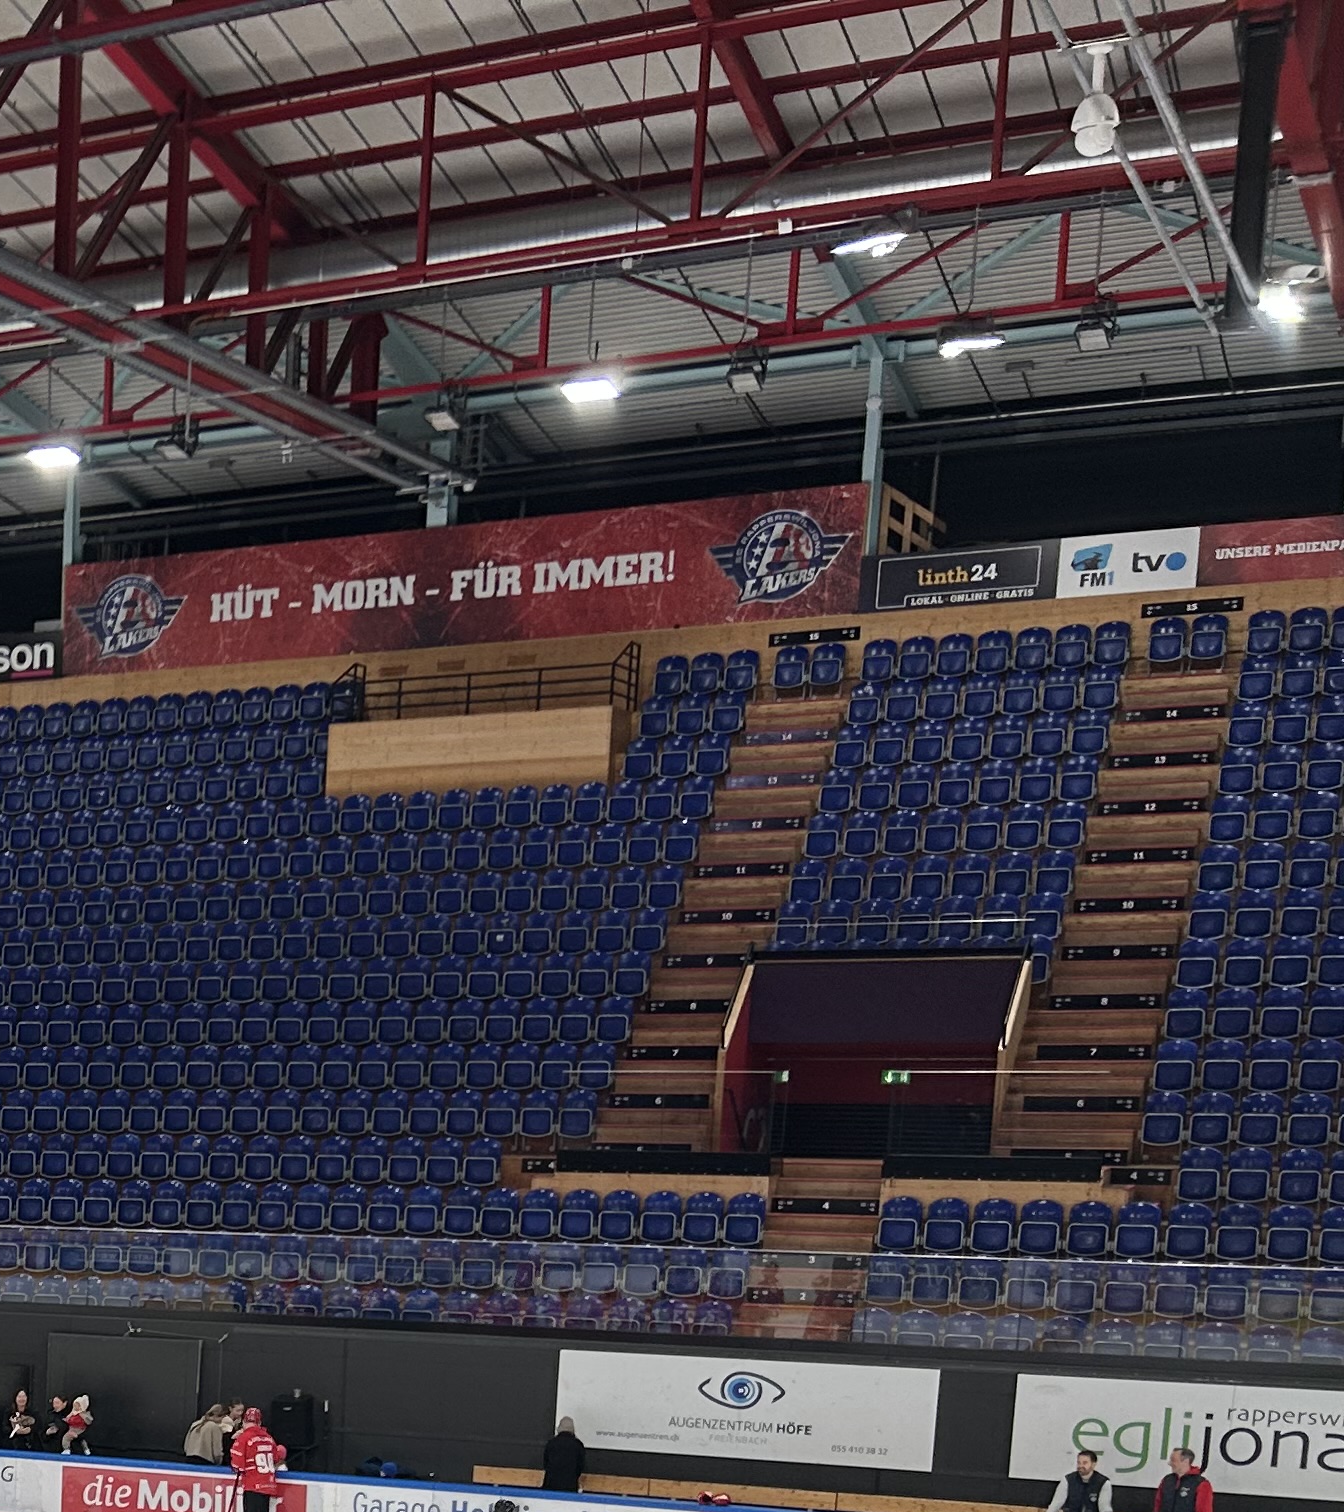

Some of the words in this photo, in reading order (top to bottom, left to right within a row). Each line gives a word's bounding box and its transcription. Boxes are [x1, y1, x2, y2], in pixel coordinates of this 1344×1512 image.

[1214, 545, 1271, 560] UNSERE
[211, 584, 279, 623] HÜT
[312, 574, 416, 614] MORN
[450, 561, 522, 602] FÜR
[532, 549, 675, 595] IMMER!
[736, 566, 816, 605] LAKERS
[917, 562, 999, 587] linth24
[910, 595, 944, 607] LOKAL
[949, 591, 990, 603] ONLINE
[995, 588, 1034, 600] GRATIS
[99, 625, 163, 661] LAKERS
[668, 1416, 773, 1434] AUGENZENTRUM
[776, 1421, 812, 1436] HÖFE
[82, 1475, 133, 1509] die
